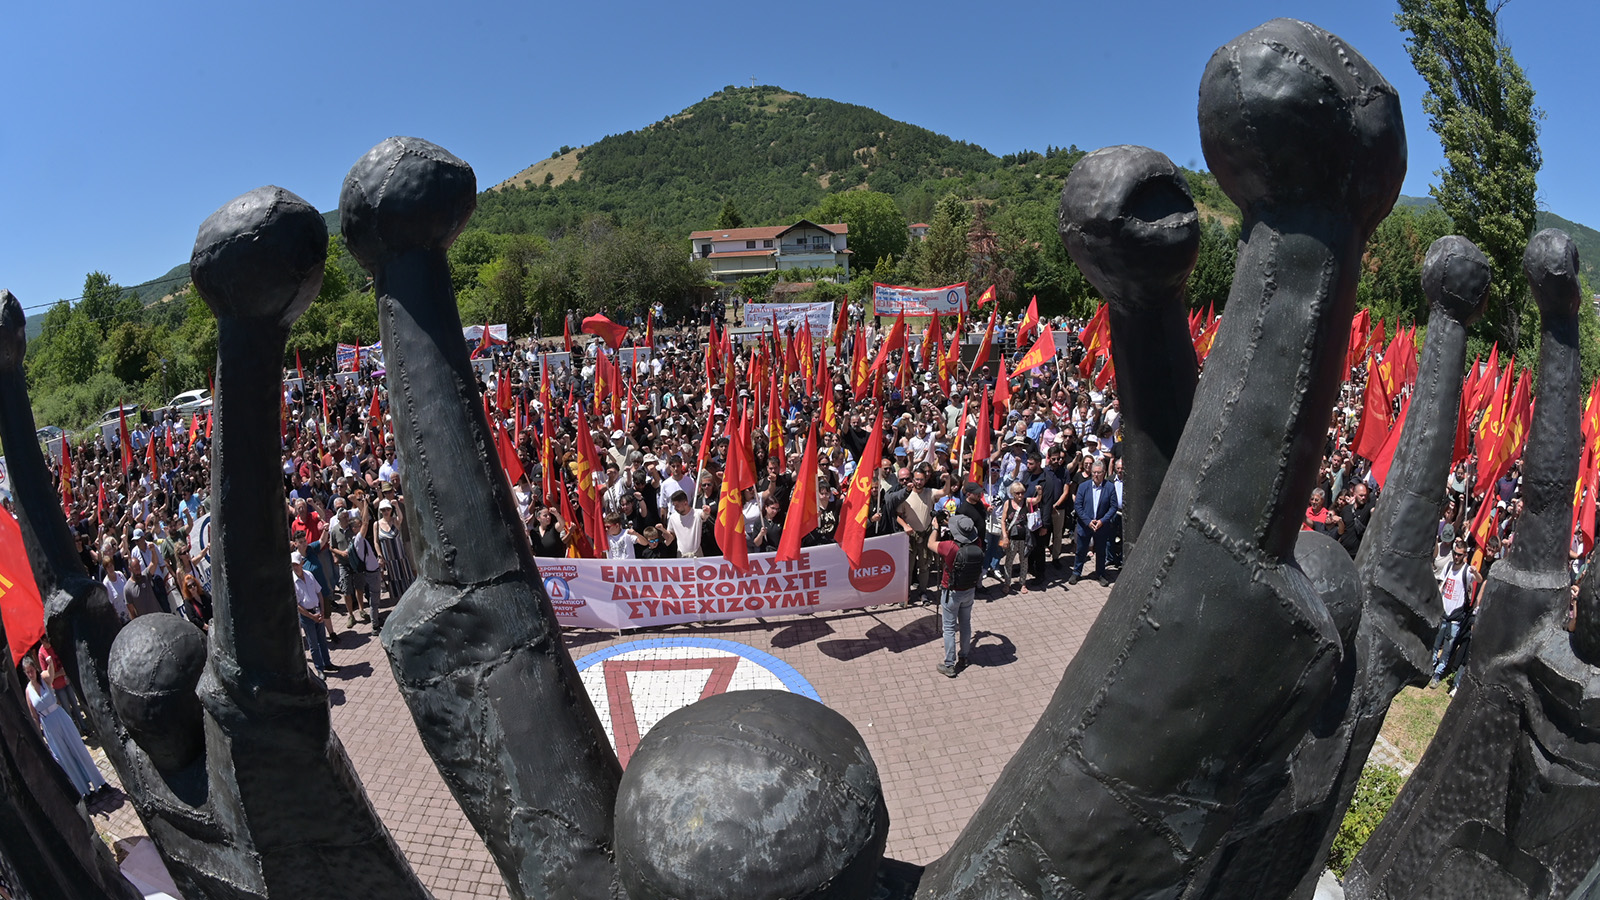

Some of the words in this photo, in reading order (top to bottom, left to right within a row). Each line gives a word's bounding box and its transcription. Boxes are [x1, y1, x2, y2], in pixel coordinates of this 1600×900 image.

[600, 552, 810, 583] ΕΜΠΝΕΟΜΑΣΤΕ
[854, 566, 879, 578] ΚΝΕ
[611, 569, 828, 600] ΔΙΔΑΣΚΟΜΑΣΤΕ
[626, 590, 820, 619] ΣΥΝΕΧΙΖΟΥΜΕ
